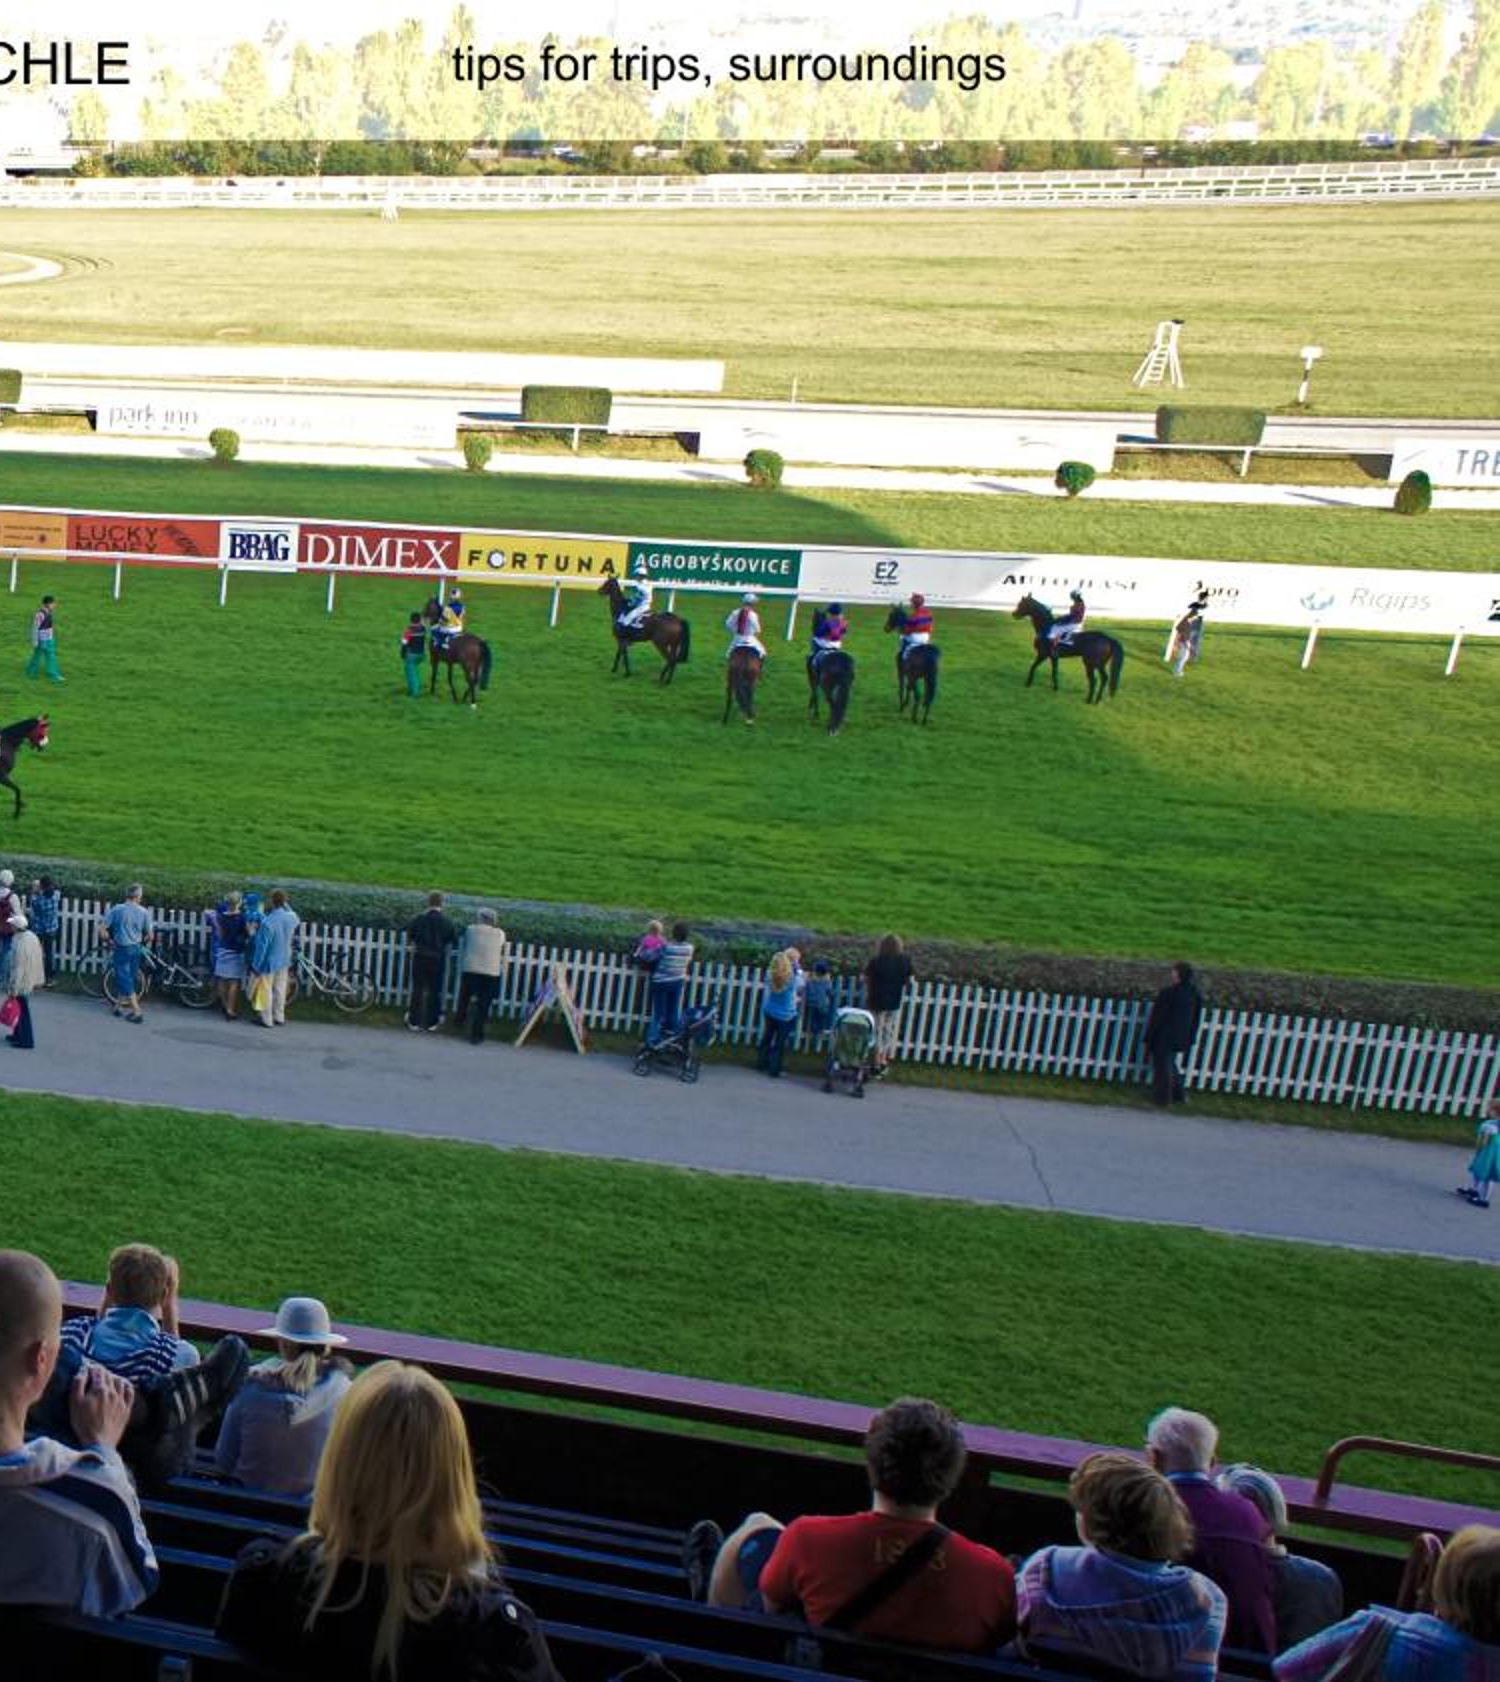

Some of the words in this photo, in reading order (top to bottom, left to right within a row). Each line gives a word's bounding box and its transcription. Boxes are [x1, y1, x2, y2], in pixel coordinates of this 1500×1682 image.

[75, 525, 158, 541] LUCKY
[229, 532, 291, 561] BBAG
[303, 532, 453, 571] DIMEX
[467, 548, 616, 575] FORTUNA
[635, 552, 792, 575] AGROBYŠKOVICE
